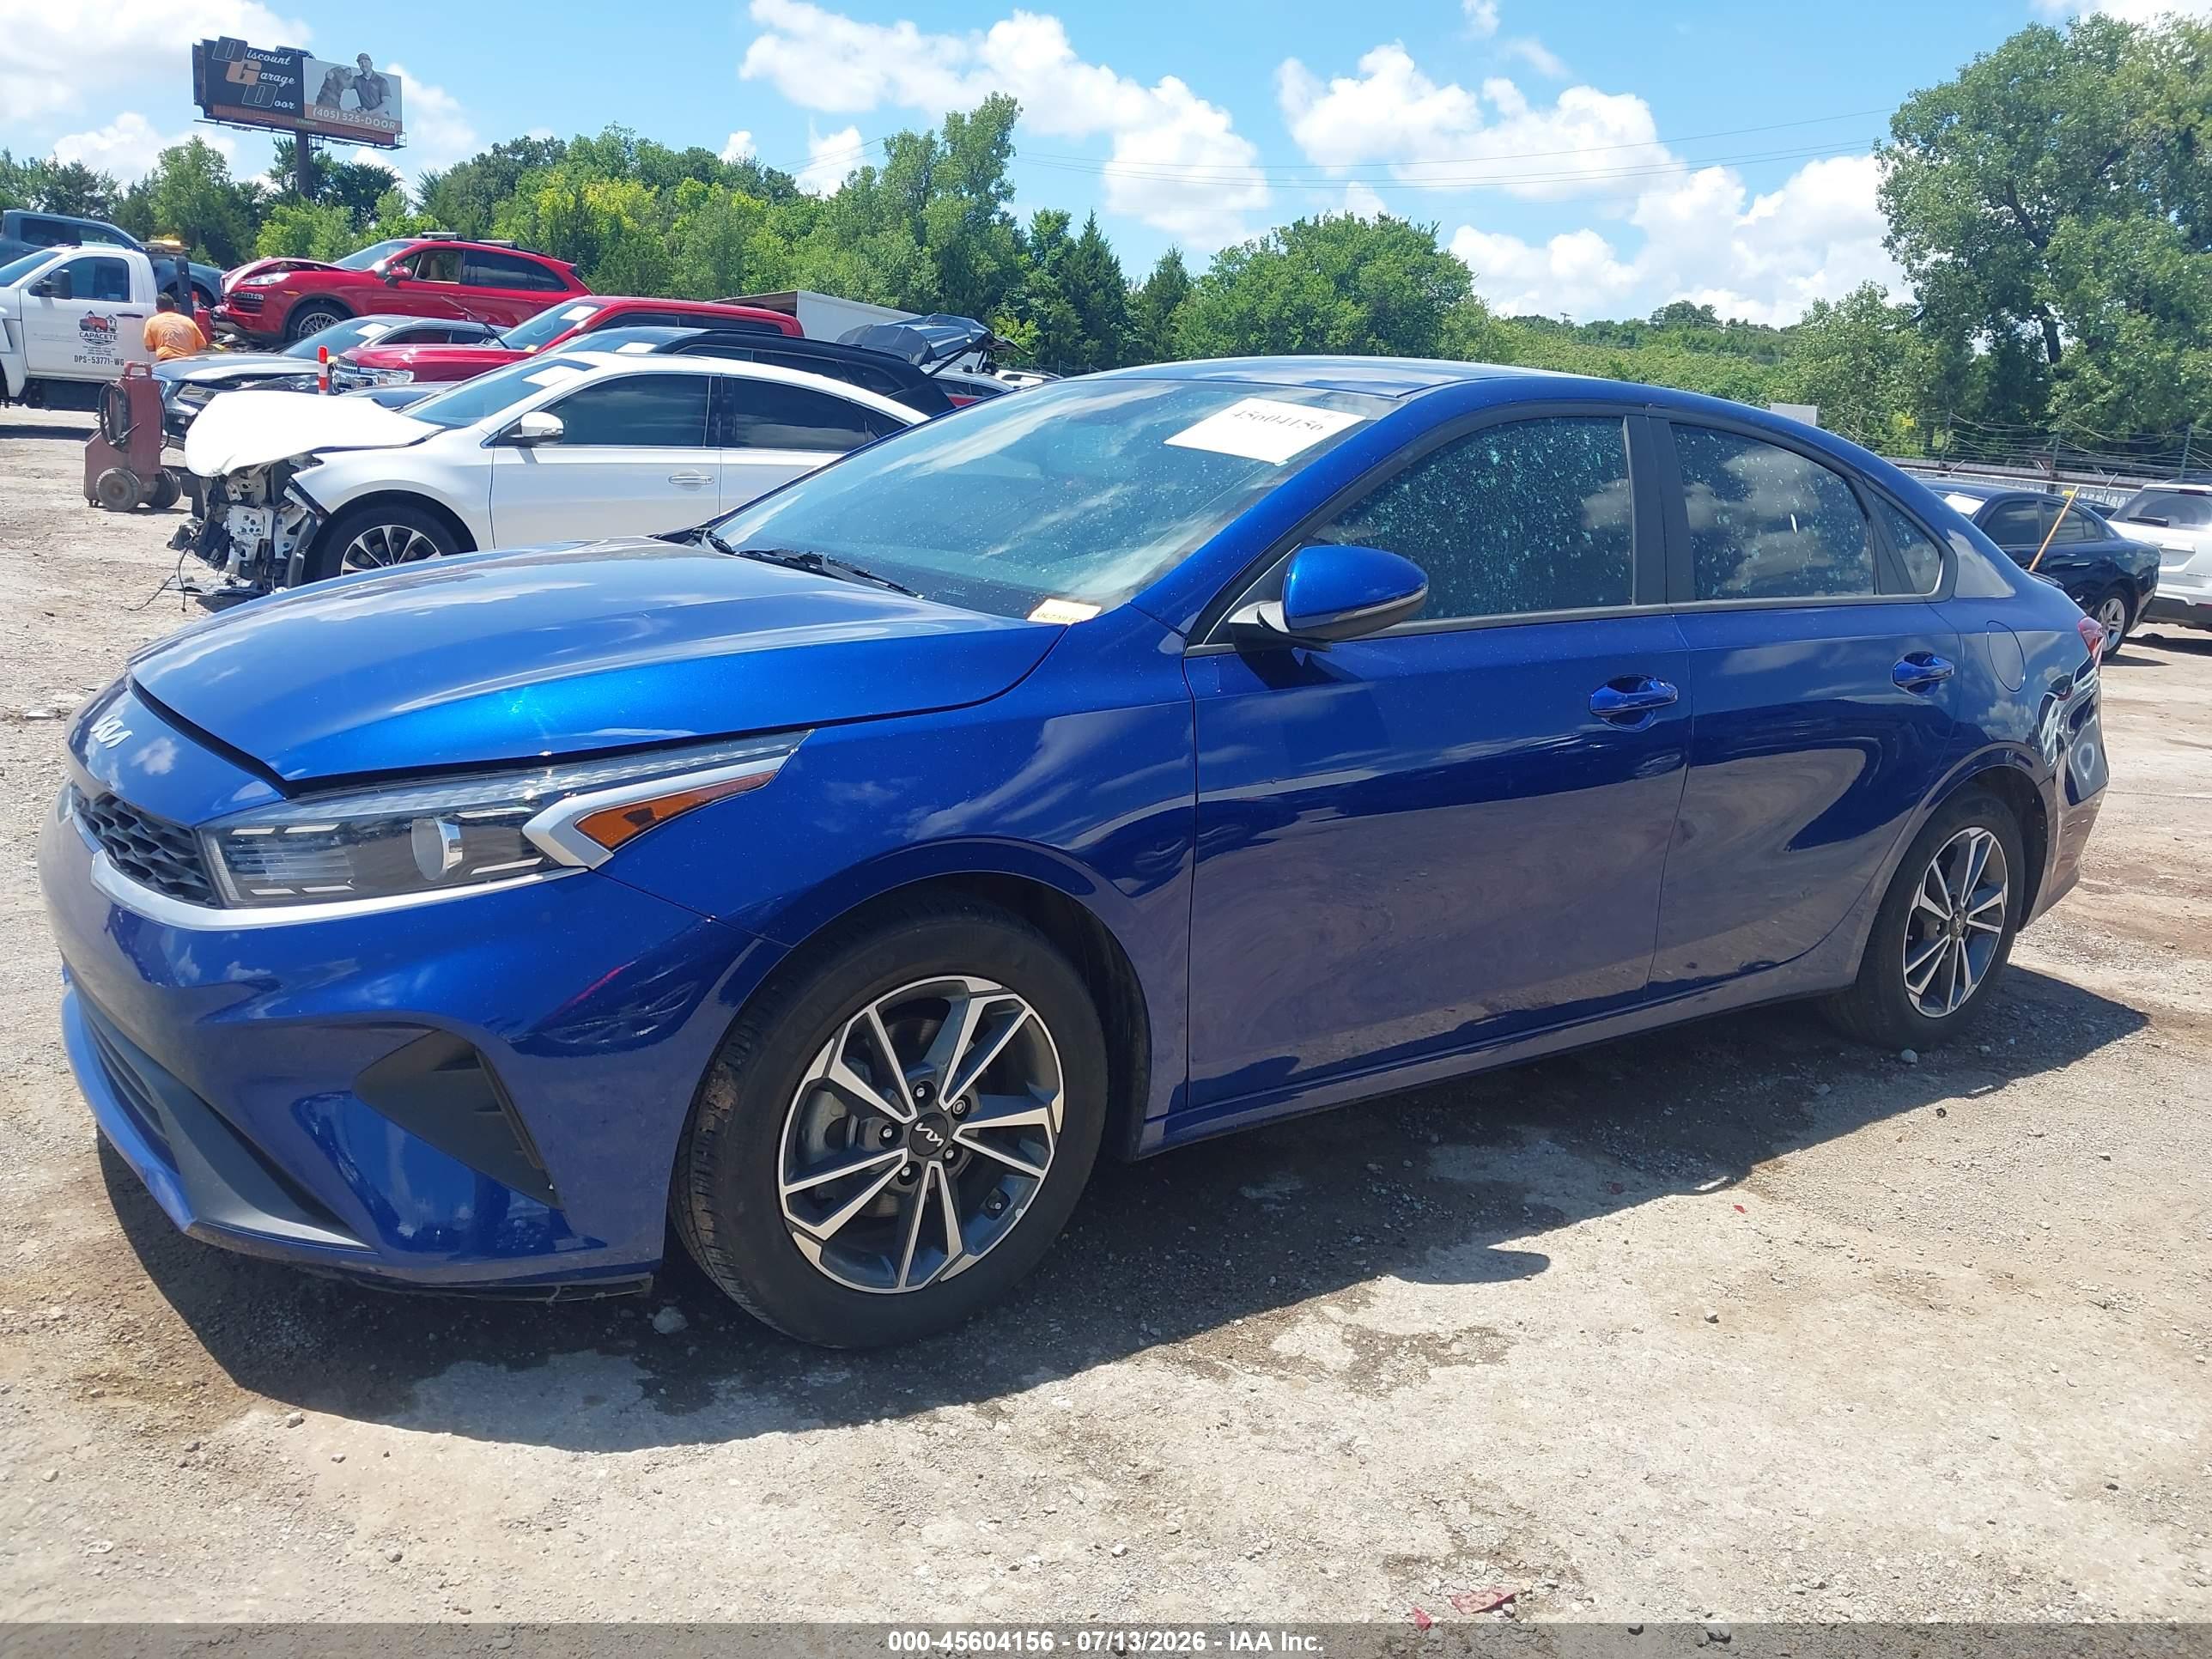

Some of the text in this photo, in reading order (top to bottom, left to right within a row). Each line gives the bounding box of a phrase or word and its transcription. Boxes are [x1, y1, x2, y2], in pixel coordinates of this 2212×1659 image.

[211, 35, 292, 66] Discount
[225, 59, 296, 88] Garage
[241, 82, 296, 109] Door
[313, 106, 397, 131] (405) 525-DOOR
